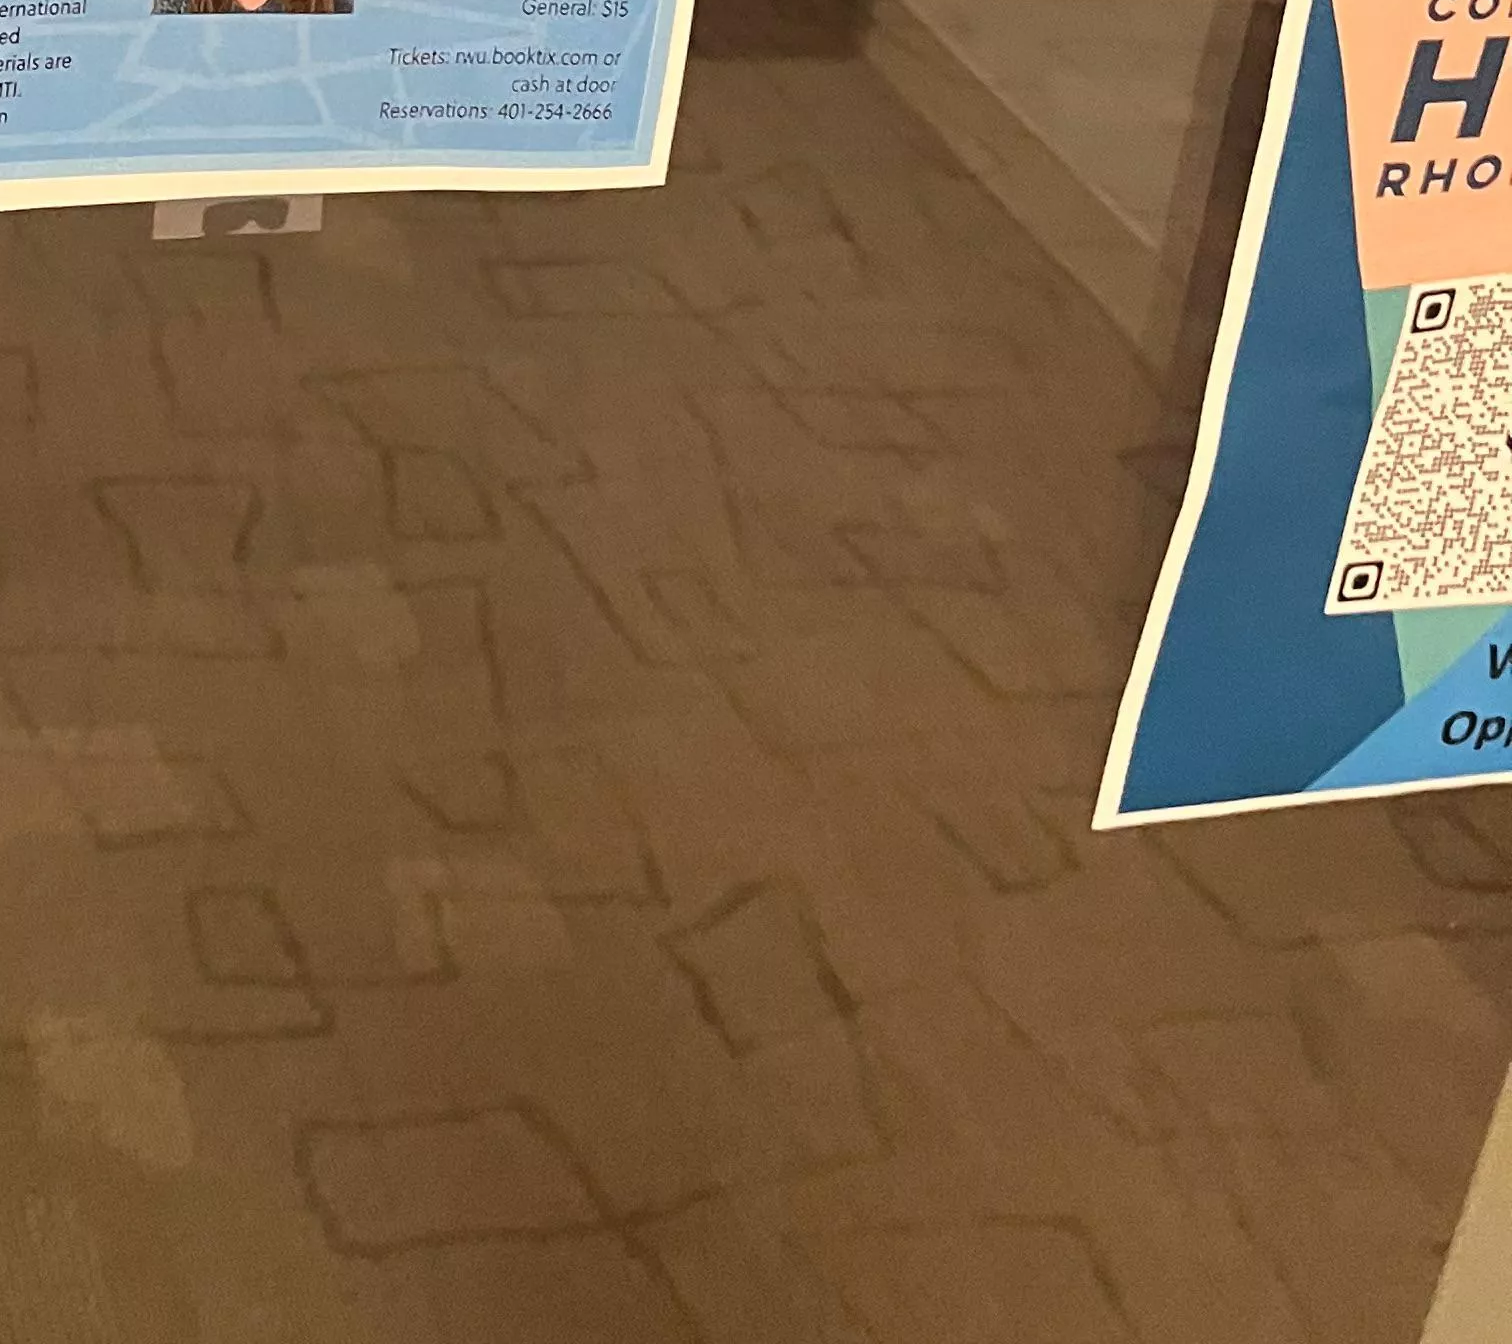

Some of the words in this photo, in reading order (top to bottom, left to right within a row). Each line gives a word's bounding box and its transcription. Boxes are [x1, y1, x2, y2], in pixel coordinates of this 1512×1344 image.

[601, 0, 629, 18] $15
[44, 55, 72, 70] are
[388, 47, 449, 66] Tickets:
[603, 52, 622, 66] or
[511, 74, 550, 94] cash
[555, 77, 571, 94] at
[576, 75, 616, 93] door
[379, 102, 493, 120] Reservations:
[497, 102, 613, 120] 401-254-2666
[1376, 154, 1512, 199] RHO
